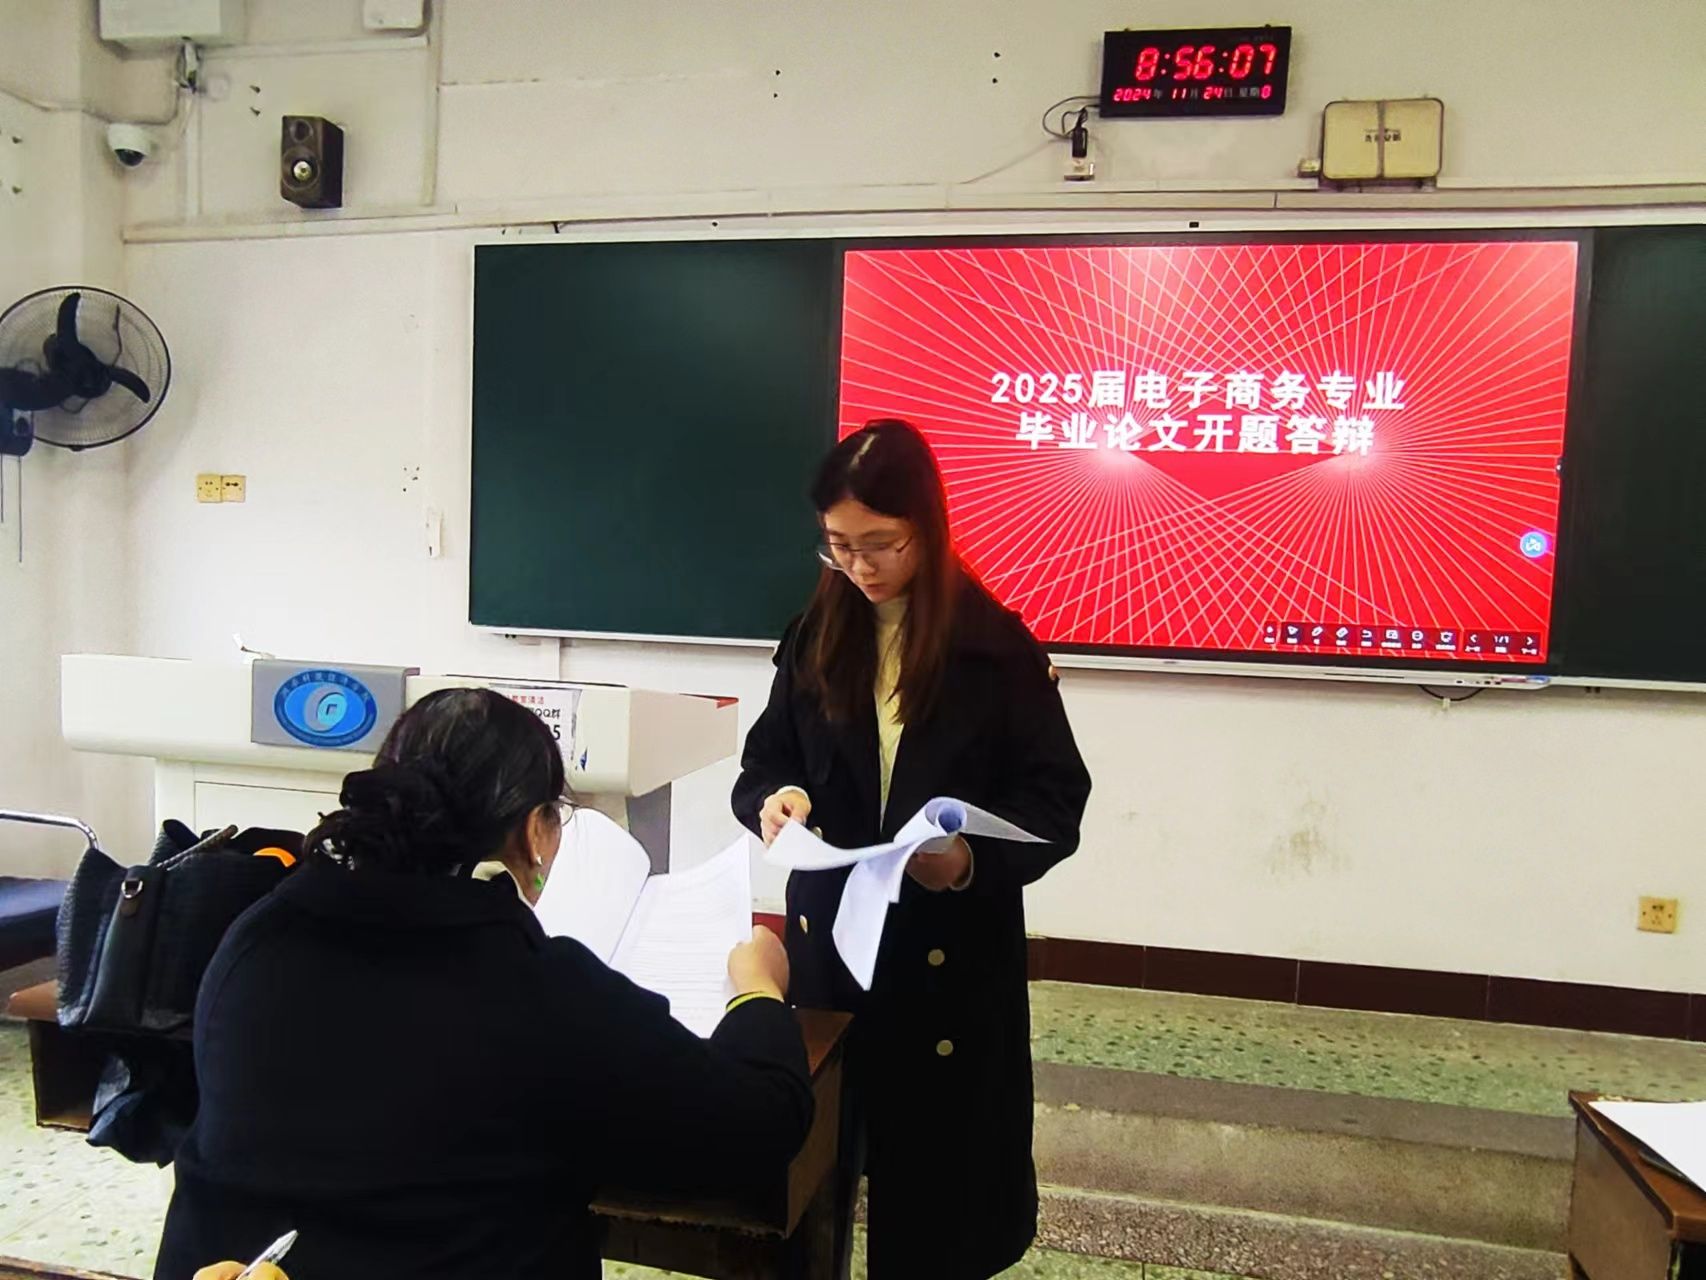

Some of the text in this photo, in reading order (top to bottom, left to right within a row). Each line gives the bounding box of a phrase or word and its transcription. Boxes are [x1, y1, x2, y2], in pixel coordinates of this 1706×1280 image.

[1135, 43, 1277, 81] 8:56:07
[991, 369, 1406, 411] 2025届电子商务专业
[1015, 411, 1375, 456] 毕业论文开题答辩
[531, 707, 561, 719] QQ群
